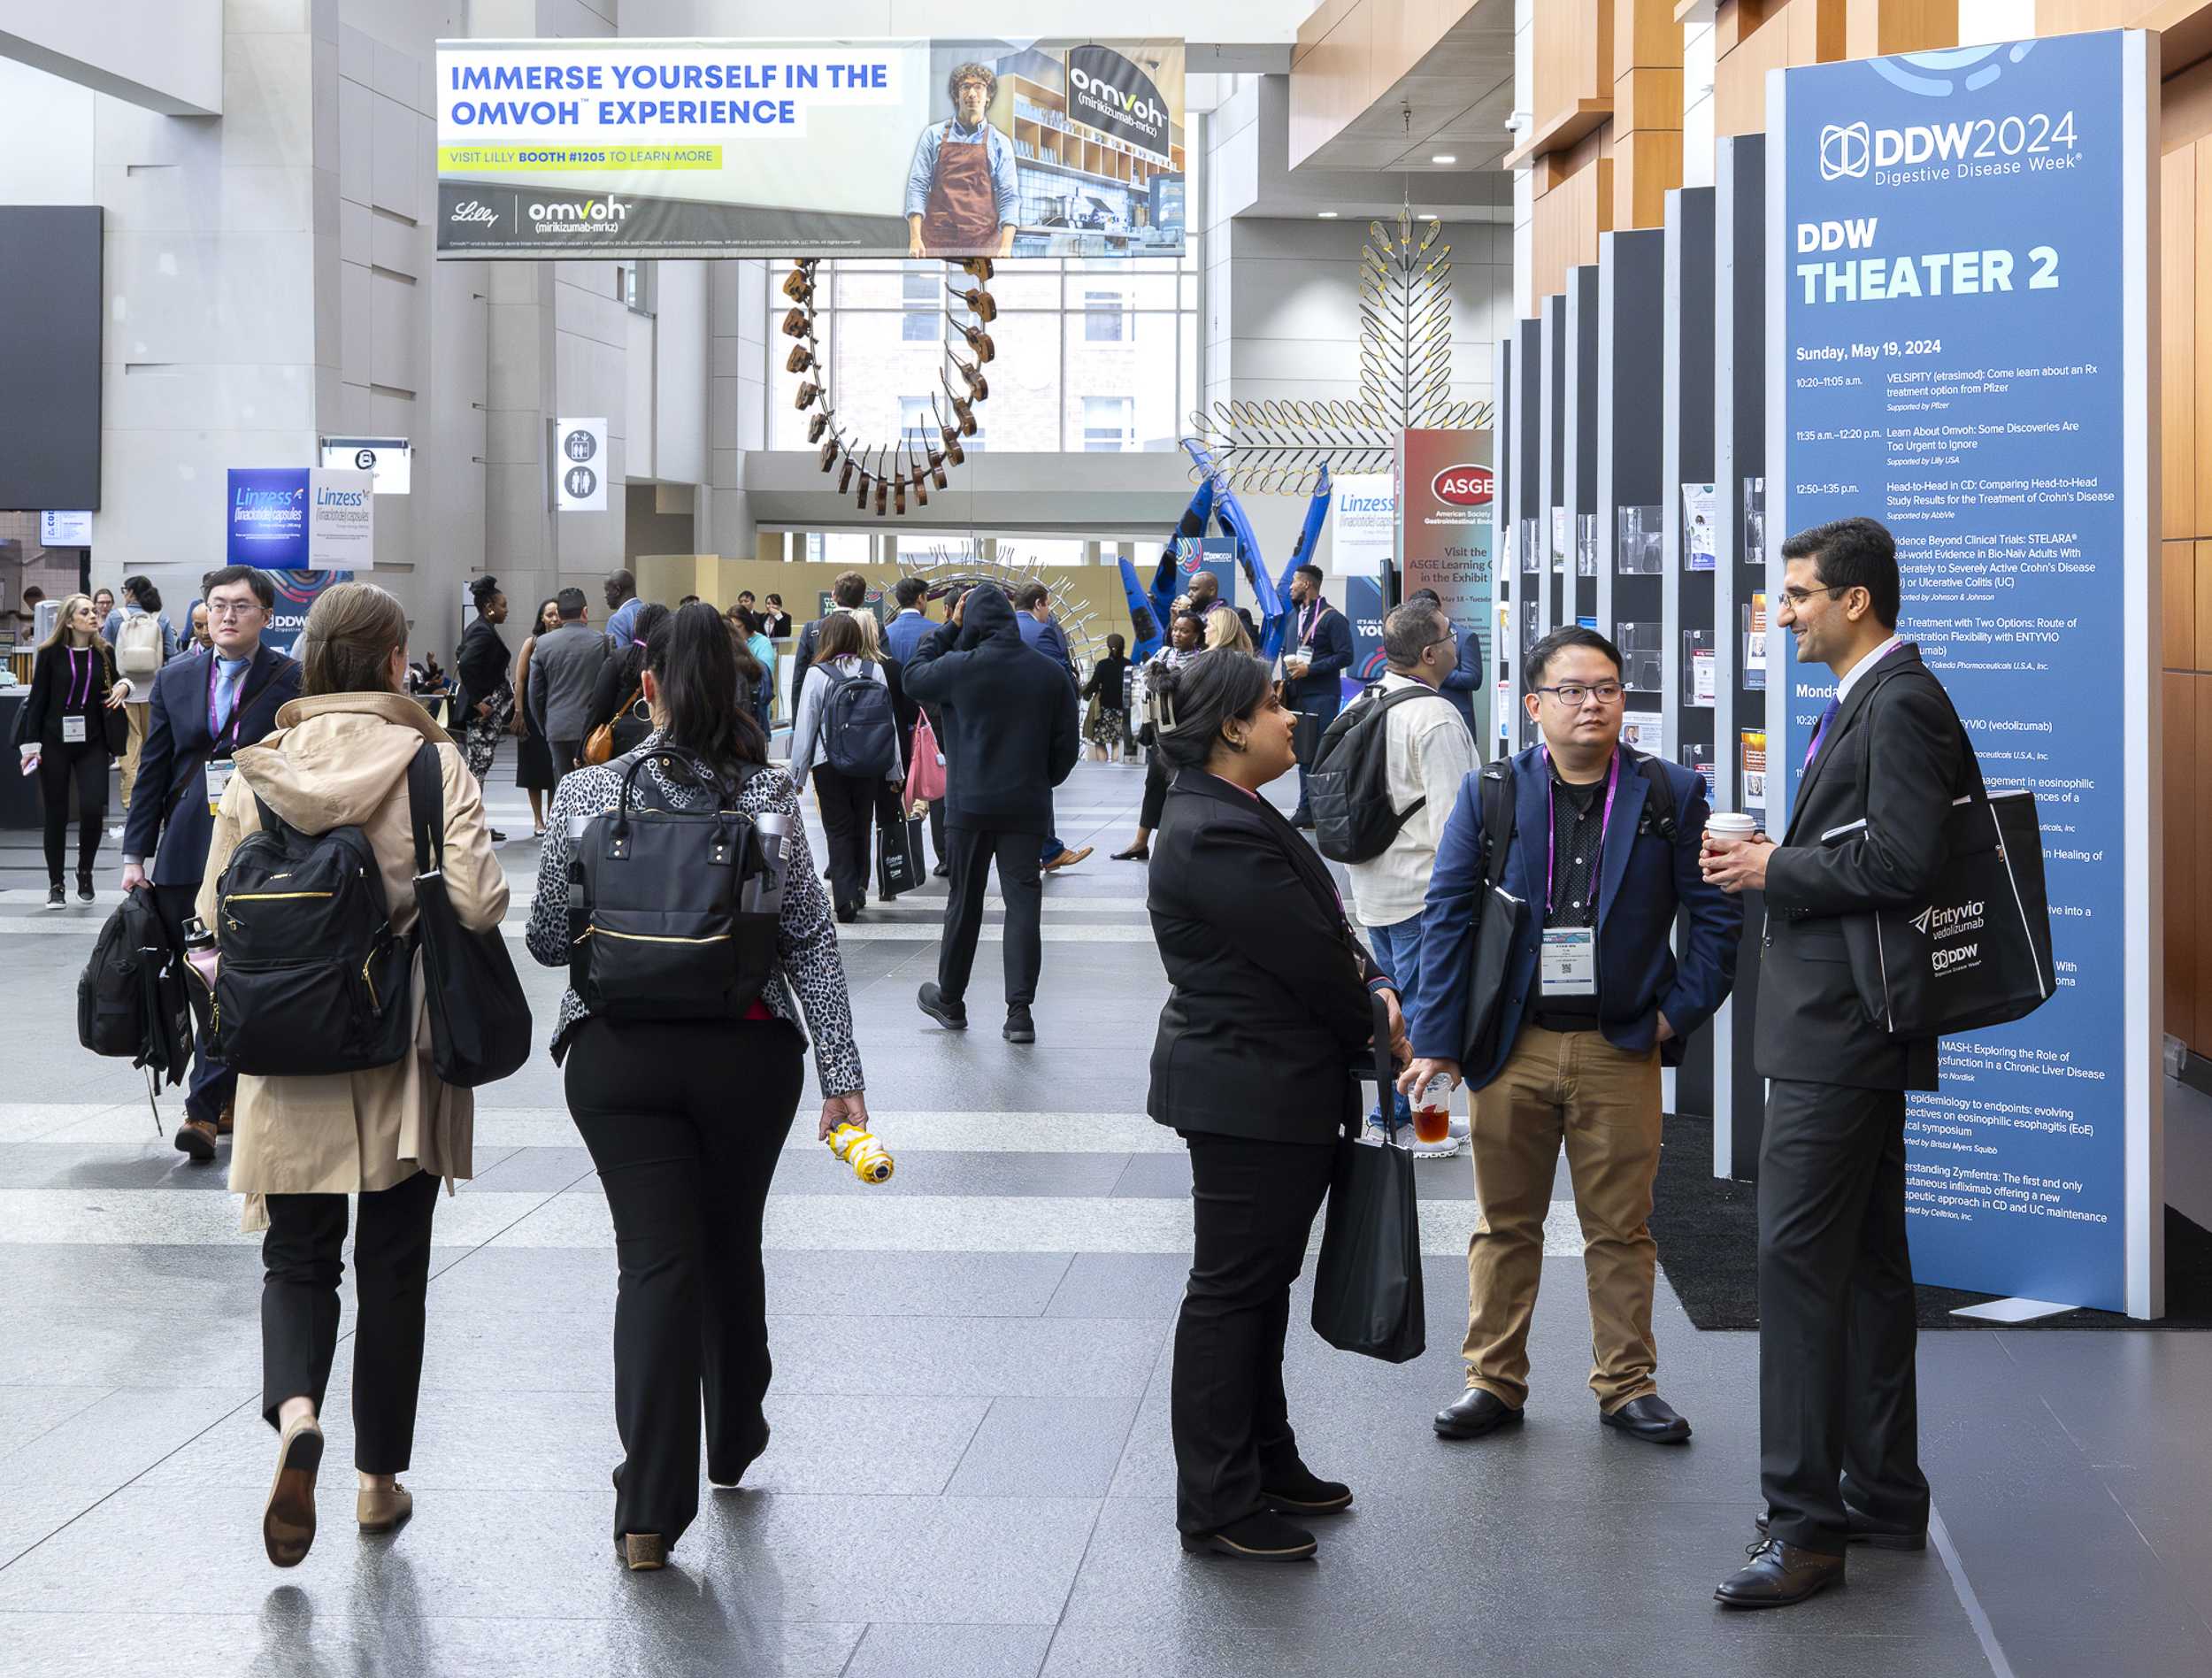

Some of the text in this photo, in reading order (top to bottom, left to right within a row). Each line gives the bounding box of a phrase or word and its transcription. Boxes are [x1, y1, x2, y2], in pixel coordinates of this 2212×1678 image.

[452, 65, 887, 89] IMMERSE YOURSELF IN THE
[599, 100, 794, 124] EXPERIENCE
[1079, 92, 1157, 138] (mirikizumab-mrkz)
[1875, 112, 2078, 165] DDW2024
[450, 151, 712, 163] VISIT LILLY BOOTH #1205 TO LEARN MORE
[1875, 166, 1950, 186] Digestive
[1957, 161, 2021, 179] Disease
[451, 201, 498, 227] Lilly
[535, 222, 618, 234] (mirikizumab-mrkz)
[1797, 218, 1877, 252] DDW
[1797, 245, 2059, 304] THEATER 2
[1796, 339, 1941, 361] Sunday, May 19, 2024
[1887, 372, 1931, 383] VELSIPITY
[1987, 368, 2014, 379] Come
[2016, 367, 2039, 377] learn
[2042, 366, 2069, 376] about
[2085, 365, 2097, 374] Rx
[1887, 383, 2008, 397] treatment option from Pfizer
[1797, 431, 1815, 441] 11:35
[1864, 429, 1881, 440] p.m.
[1887, 422, 2078, 437] Learn About Omvoh: Some Discoveries Are
[1887, 442, 1903, 451] Too
[1907, 441, 1936, 452] Urgent
[1949, 440, 1978, 451] Ignore
[1442, 479, 1494, 494] ASGE
[1841, 483, 1859, 495] p.m.
[1887, 478, 2097, 492] Head-to-Head in CD: Comparing Head-to-Head
[236, 488, 292, 505] Linzess
[318, 488, 361, 506] Linzess
[1340, 494, 1394, 512] Linzess
[1887, 495, 1911, 507] Study
[1914, 495, 1945, 505] Results
[1947, 495, 1960, 504] for
[1962, 495, 1976, 504] the
[1978, 494, 2024, 504] Treatment
[2027, 493, 2037, 503] of
[2077, 492, 2114, 501] Disease
[274, 508, 302, 523] capsules
[1893, 535, 1925, 545] vidence
[1929, 535, 1962, 547] Beyond
[1964, 535, 1996, 545] Clinical
[2000, 535, 2025, 544] Trials:
[1445, 547, 1486, 557] Visit the
[1935, 550, 1975, 559] Evidence
[1978, 550, 1985, 558] in
[2029, 548, 2057, 558] Adults
[2060, 548, 2081, 558] With
[1409, 560, 1485, 572] ASGE Learning
[1948, 563, 1986, 574] Severely
[1990, 563, 2017, 573] Active
[2058, 563, 2095, 573] Disease
[1421, 573, 1487, 583] in the Exhibit
[1908, 577, 2015, 588] or Ulcerative Colitis (UC)
[1908, 618, 2077, 629] Treatment with Two Options: Route of
[1894, 632, 2059, 643] dministration Flexibility with ENTYVIO
[1989, 720, 2052, 733] (vedolizumab)
[1932, 901, 1985, 928] Entyvio
[1933, 917, 1984, 940] vedolizumab
[1948, 943, 1978, 963] DDW
[1942, 1041, 2070, 1061] MASH: Exploring the Role of
[1939, 1056, 1983, 1068] ysfunction
[1985, 1060, 1993, 1069] in
[2004, 1061, 2039, 1074] Chronic
[2042, 1065, 2064, 1076] Liver
[2067, 1067, 2105, 1080] Disease
[1911, 1094, 2073, 1120] epidemiology to endpoints: evolving
[1953, 1166, 2082, 1193] Zymfentra: The first and only
[1938, 1195, 2108, 1223] approach in CD and UC maintenance
